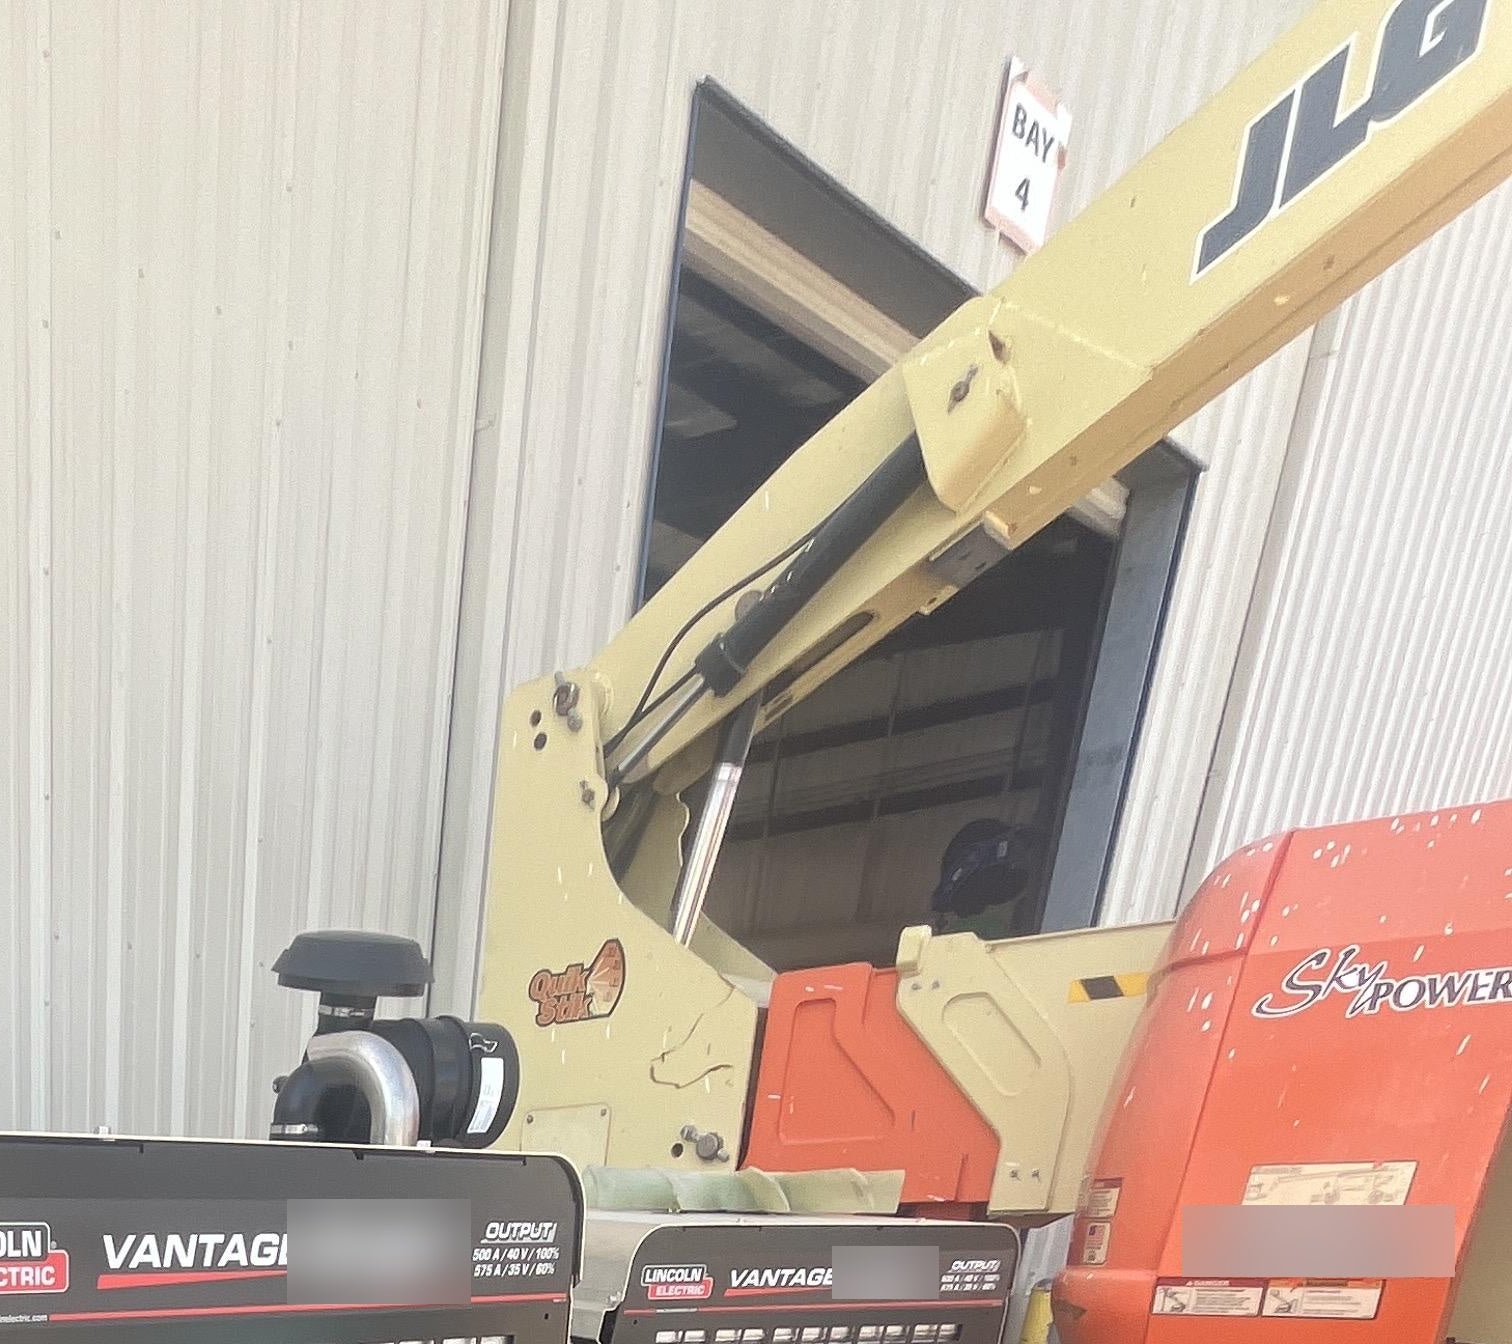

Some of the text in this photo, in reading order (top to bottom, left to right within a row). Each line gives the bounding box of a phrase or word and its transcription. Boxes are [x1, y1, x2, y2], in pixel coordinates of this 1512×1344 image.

[1012, 102, 1055, 163] BAY
[1191, 0, 1488, 282] JLG
[1015, 177, 1030, 212] 4
[485, 1222, 554, 1239] OUTPUT
[951, 1260, 999, 1271] OUTPUT
[645, 1268, 702, 1283] LINCOLN
[656, 1285, 705, 1296] ELECTRIC
